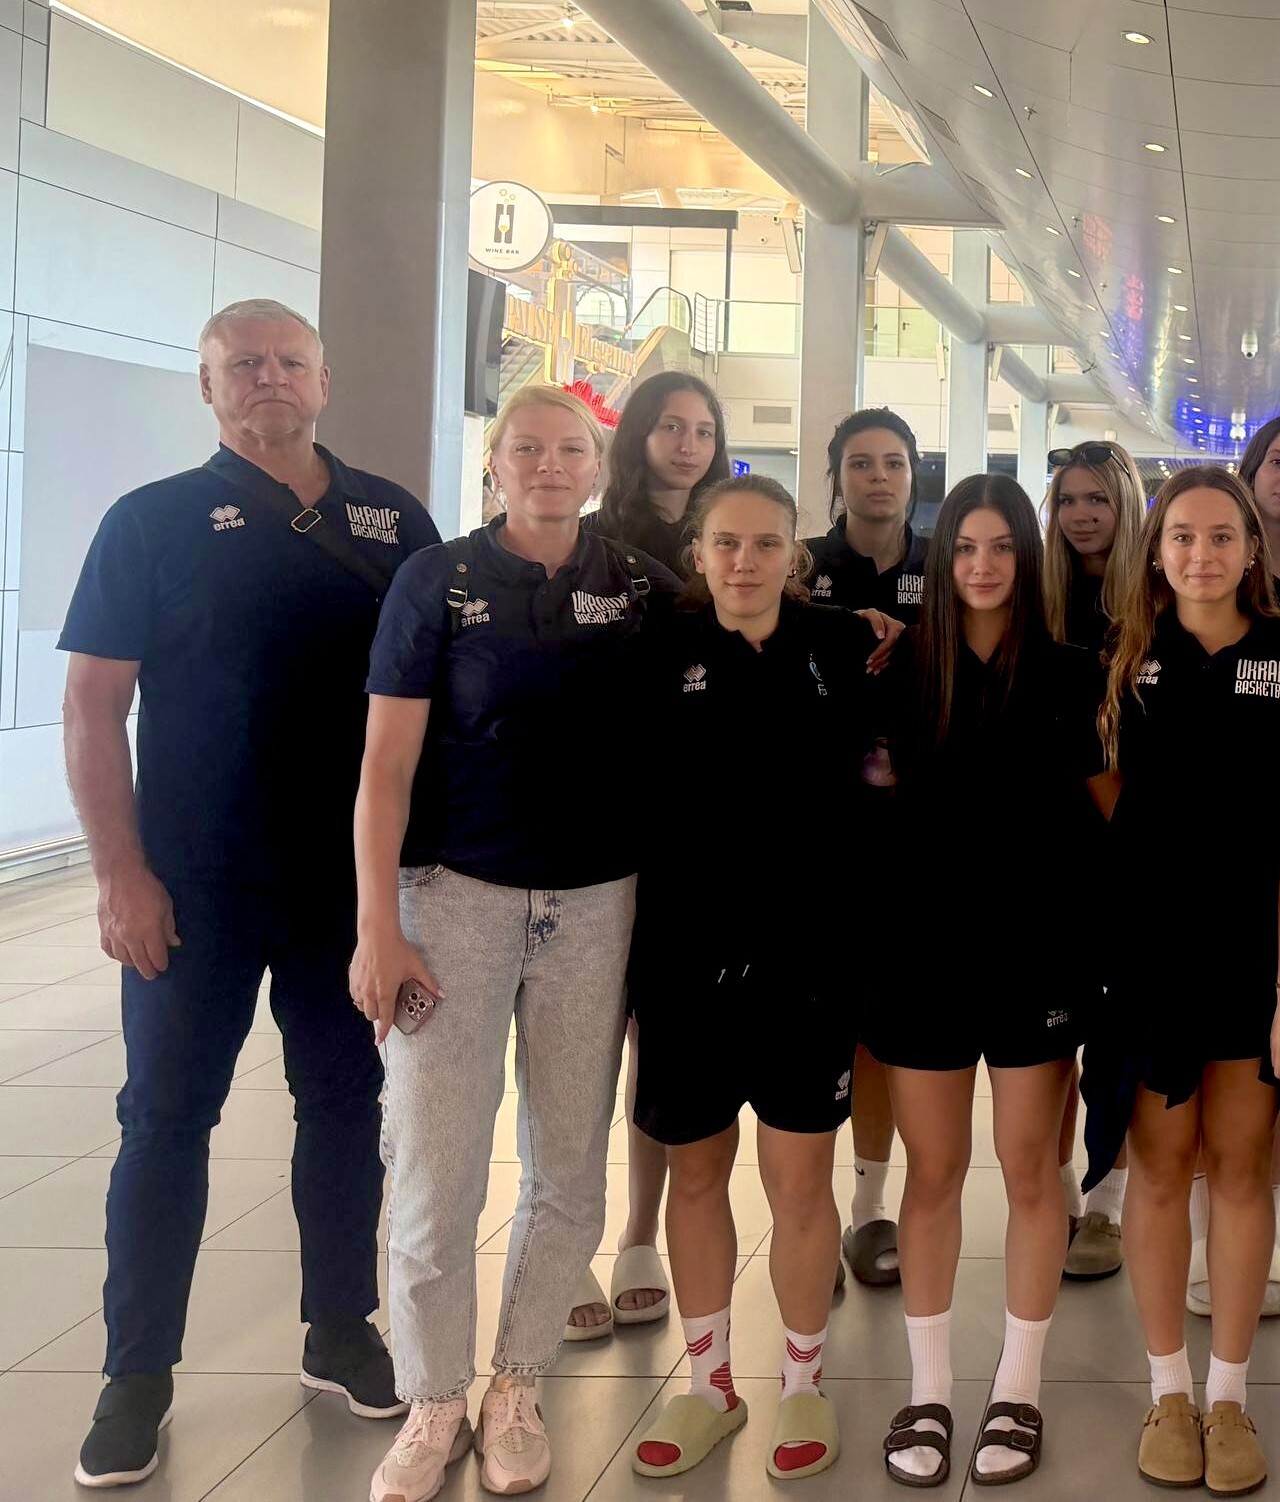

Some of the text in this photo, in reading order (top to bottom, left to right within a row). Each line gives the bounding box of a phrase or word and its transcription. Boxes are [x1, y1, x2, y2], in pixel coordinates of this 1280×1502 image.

[212, 517, 246, 532] errea
[460, 612, 490, 627] errea
[682, 680, 706, 693] errea
